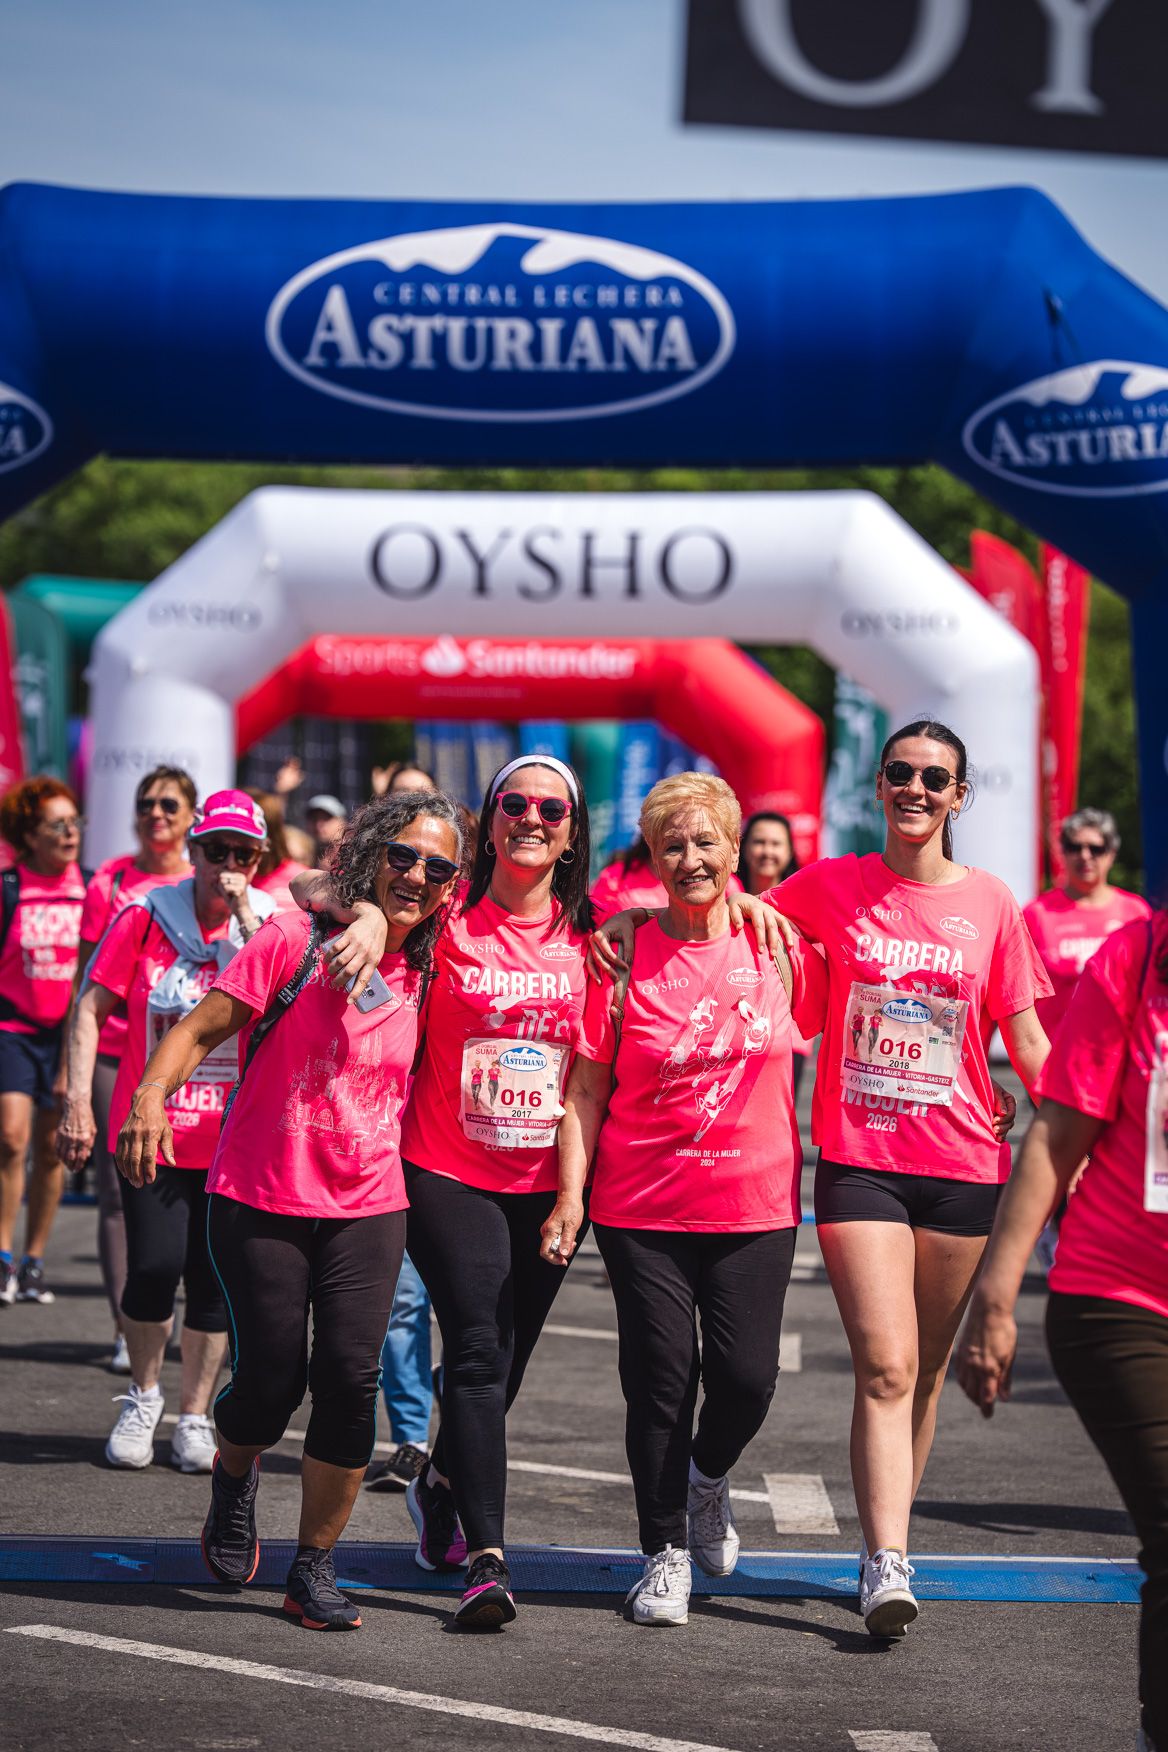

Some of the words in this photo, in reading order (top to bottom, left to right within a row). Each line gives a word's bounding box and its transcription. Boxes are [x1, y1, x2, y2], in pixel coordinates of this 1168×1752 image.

[373, 281, 518, 307] CENTRAL
[533, 284, 684, 308] LECHERA
[303, 284, 697, 372] ASTURIANA
[367, 522, 737, 605] OYSHO
[148, 602, 262, 632] OYSHO
[840, 609, 960, 638] OYSHO
[314, 635, 420, 677] Sports
[466, 638, 639, 679] Santander
[855, 906, 903, 921] OYSHO
[943, 920, 978, 938] ASTURIANA
[459, 943, 505, 955] OYSHO
[855, 933, 964, 979] CARRERA
[461, 966, 573, 1001] CARRERA
[641, 977, 690, 996] OYSHO
[859, 994, 882, 1004] SUMA
[886, 1005, 929, 1020] ASTURIANA
[475, 1048, 498, 1056] SUMA
[879, 1038, 923, 1060] 016
[503, 1055, 544, 1067] ASTURIANA
[888, 1059, 910, 1070] 2018
[845, 1060, 866, 1072] CARRERA
[866, 1065, 874, 1073] DE
[874, 1067, 882, 1075] LA
[882, 1068, 902, 1078] MUJER
[905, 1072, 951, 1086] VITORIA-GASTEIZ
[850, 1074, 885, 1090] OYSHO
[166, 1082, 225, 1112] UJER
[500, 1089, 542, 1108] 016
[906, 1086, 940, 1098] Santander
[173, 1111, 200, 1128] 2026
[511, 1110, 532, 1119] 2017
[865, 1113, 898, 1133] 2026
[476, 1127, 510, 1140] OYSHO
[675, 1149, 702, 1158] CARRERA
[703, 1150, 712, 1158] DE
[712, 1150, 721, 1158] LA
[721, 1149, 741, 1158] MUJER
[700, 1158, 716, 1167] 2024
